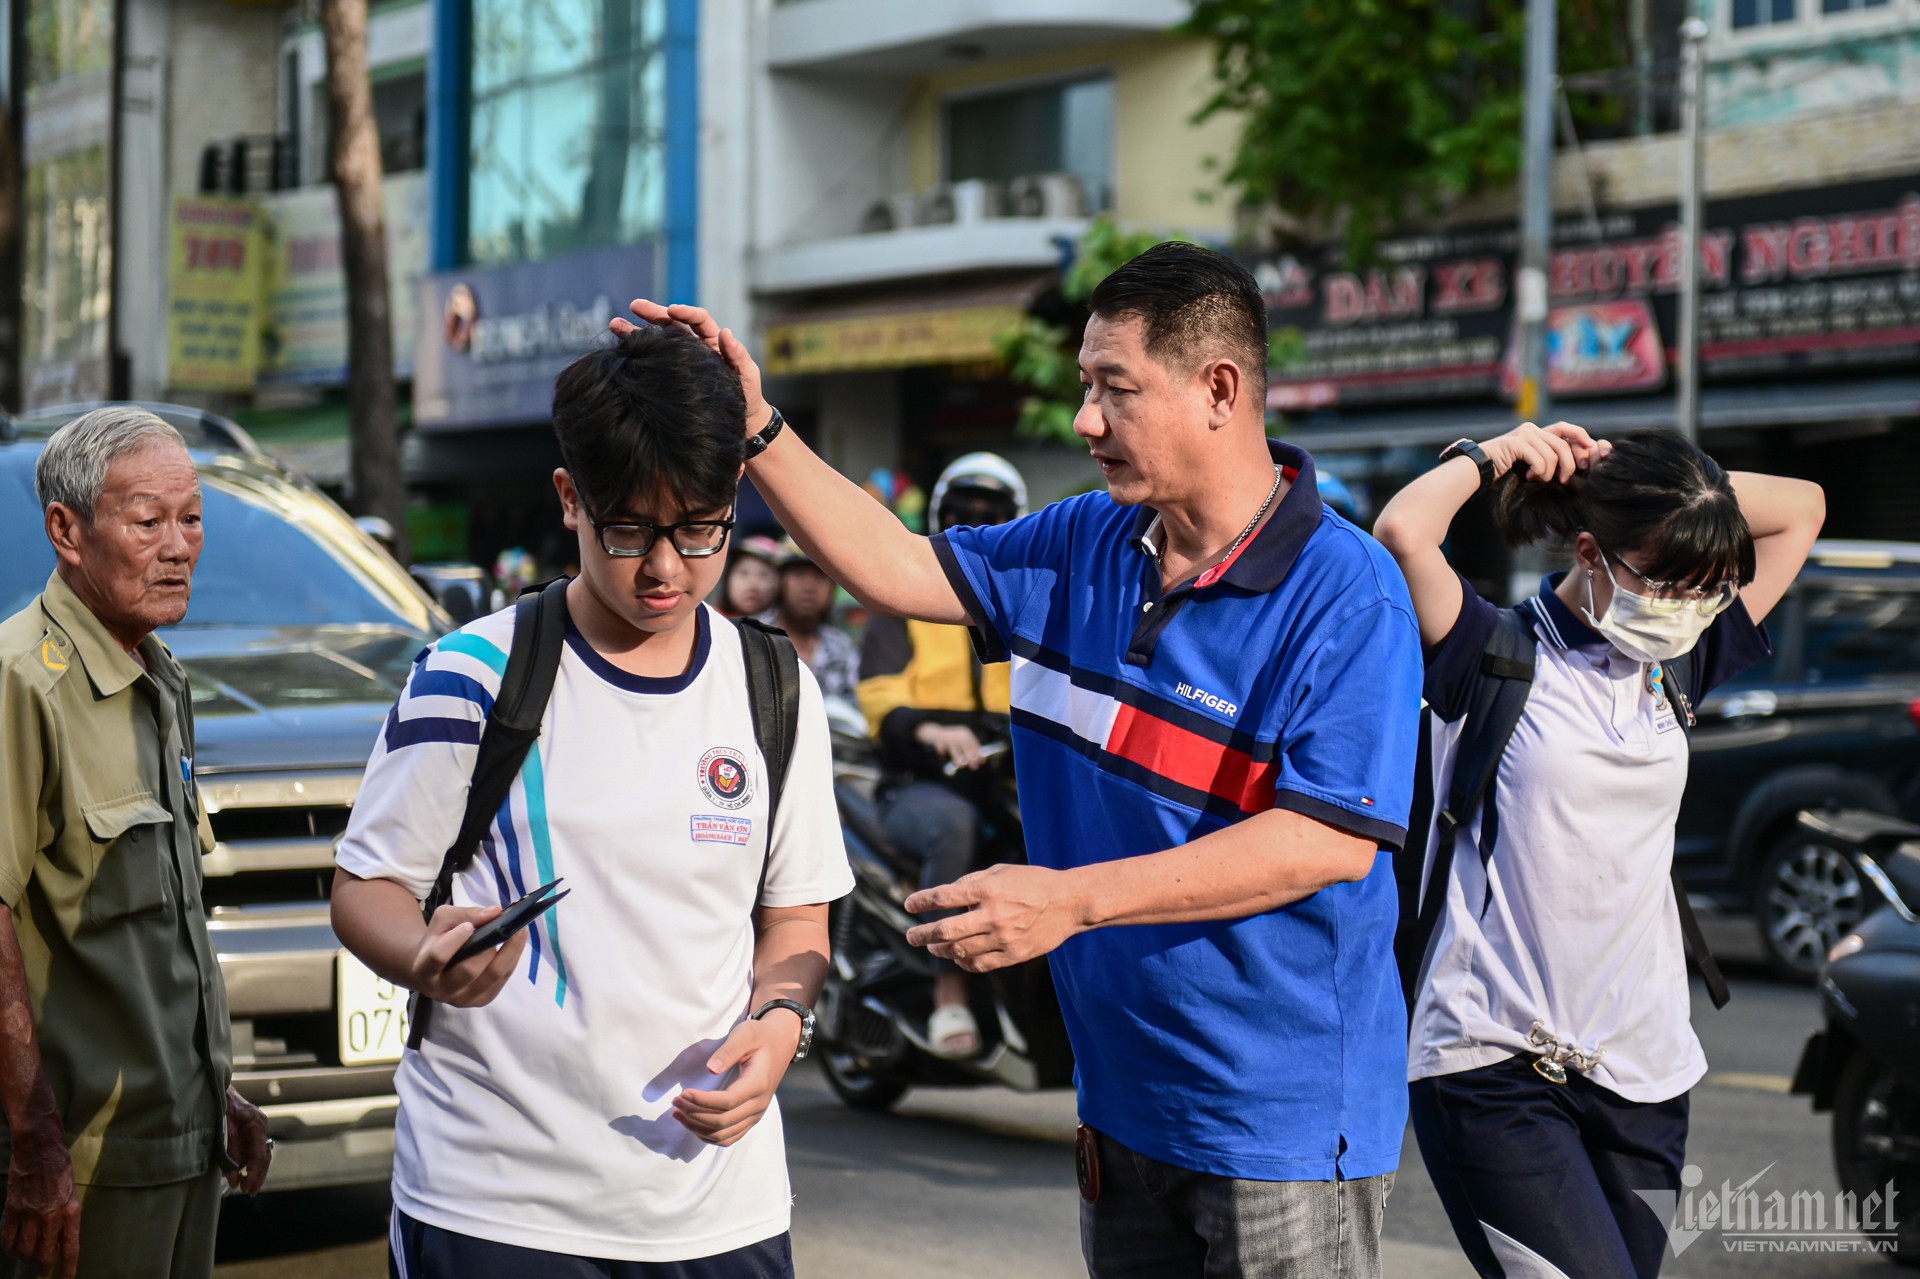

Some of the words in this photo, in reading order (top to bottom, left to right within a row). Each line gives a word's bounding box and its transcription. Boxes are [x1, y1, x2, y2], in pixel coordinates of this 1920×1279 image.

[1175, 682, 1238, 717] HILFIGER
[696, 821, 718, 830] TRẦN
[719, 823, 735, 832] VĂN
